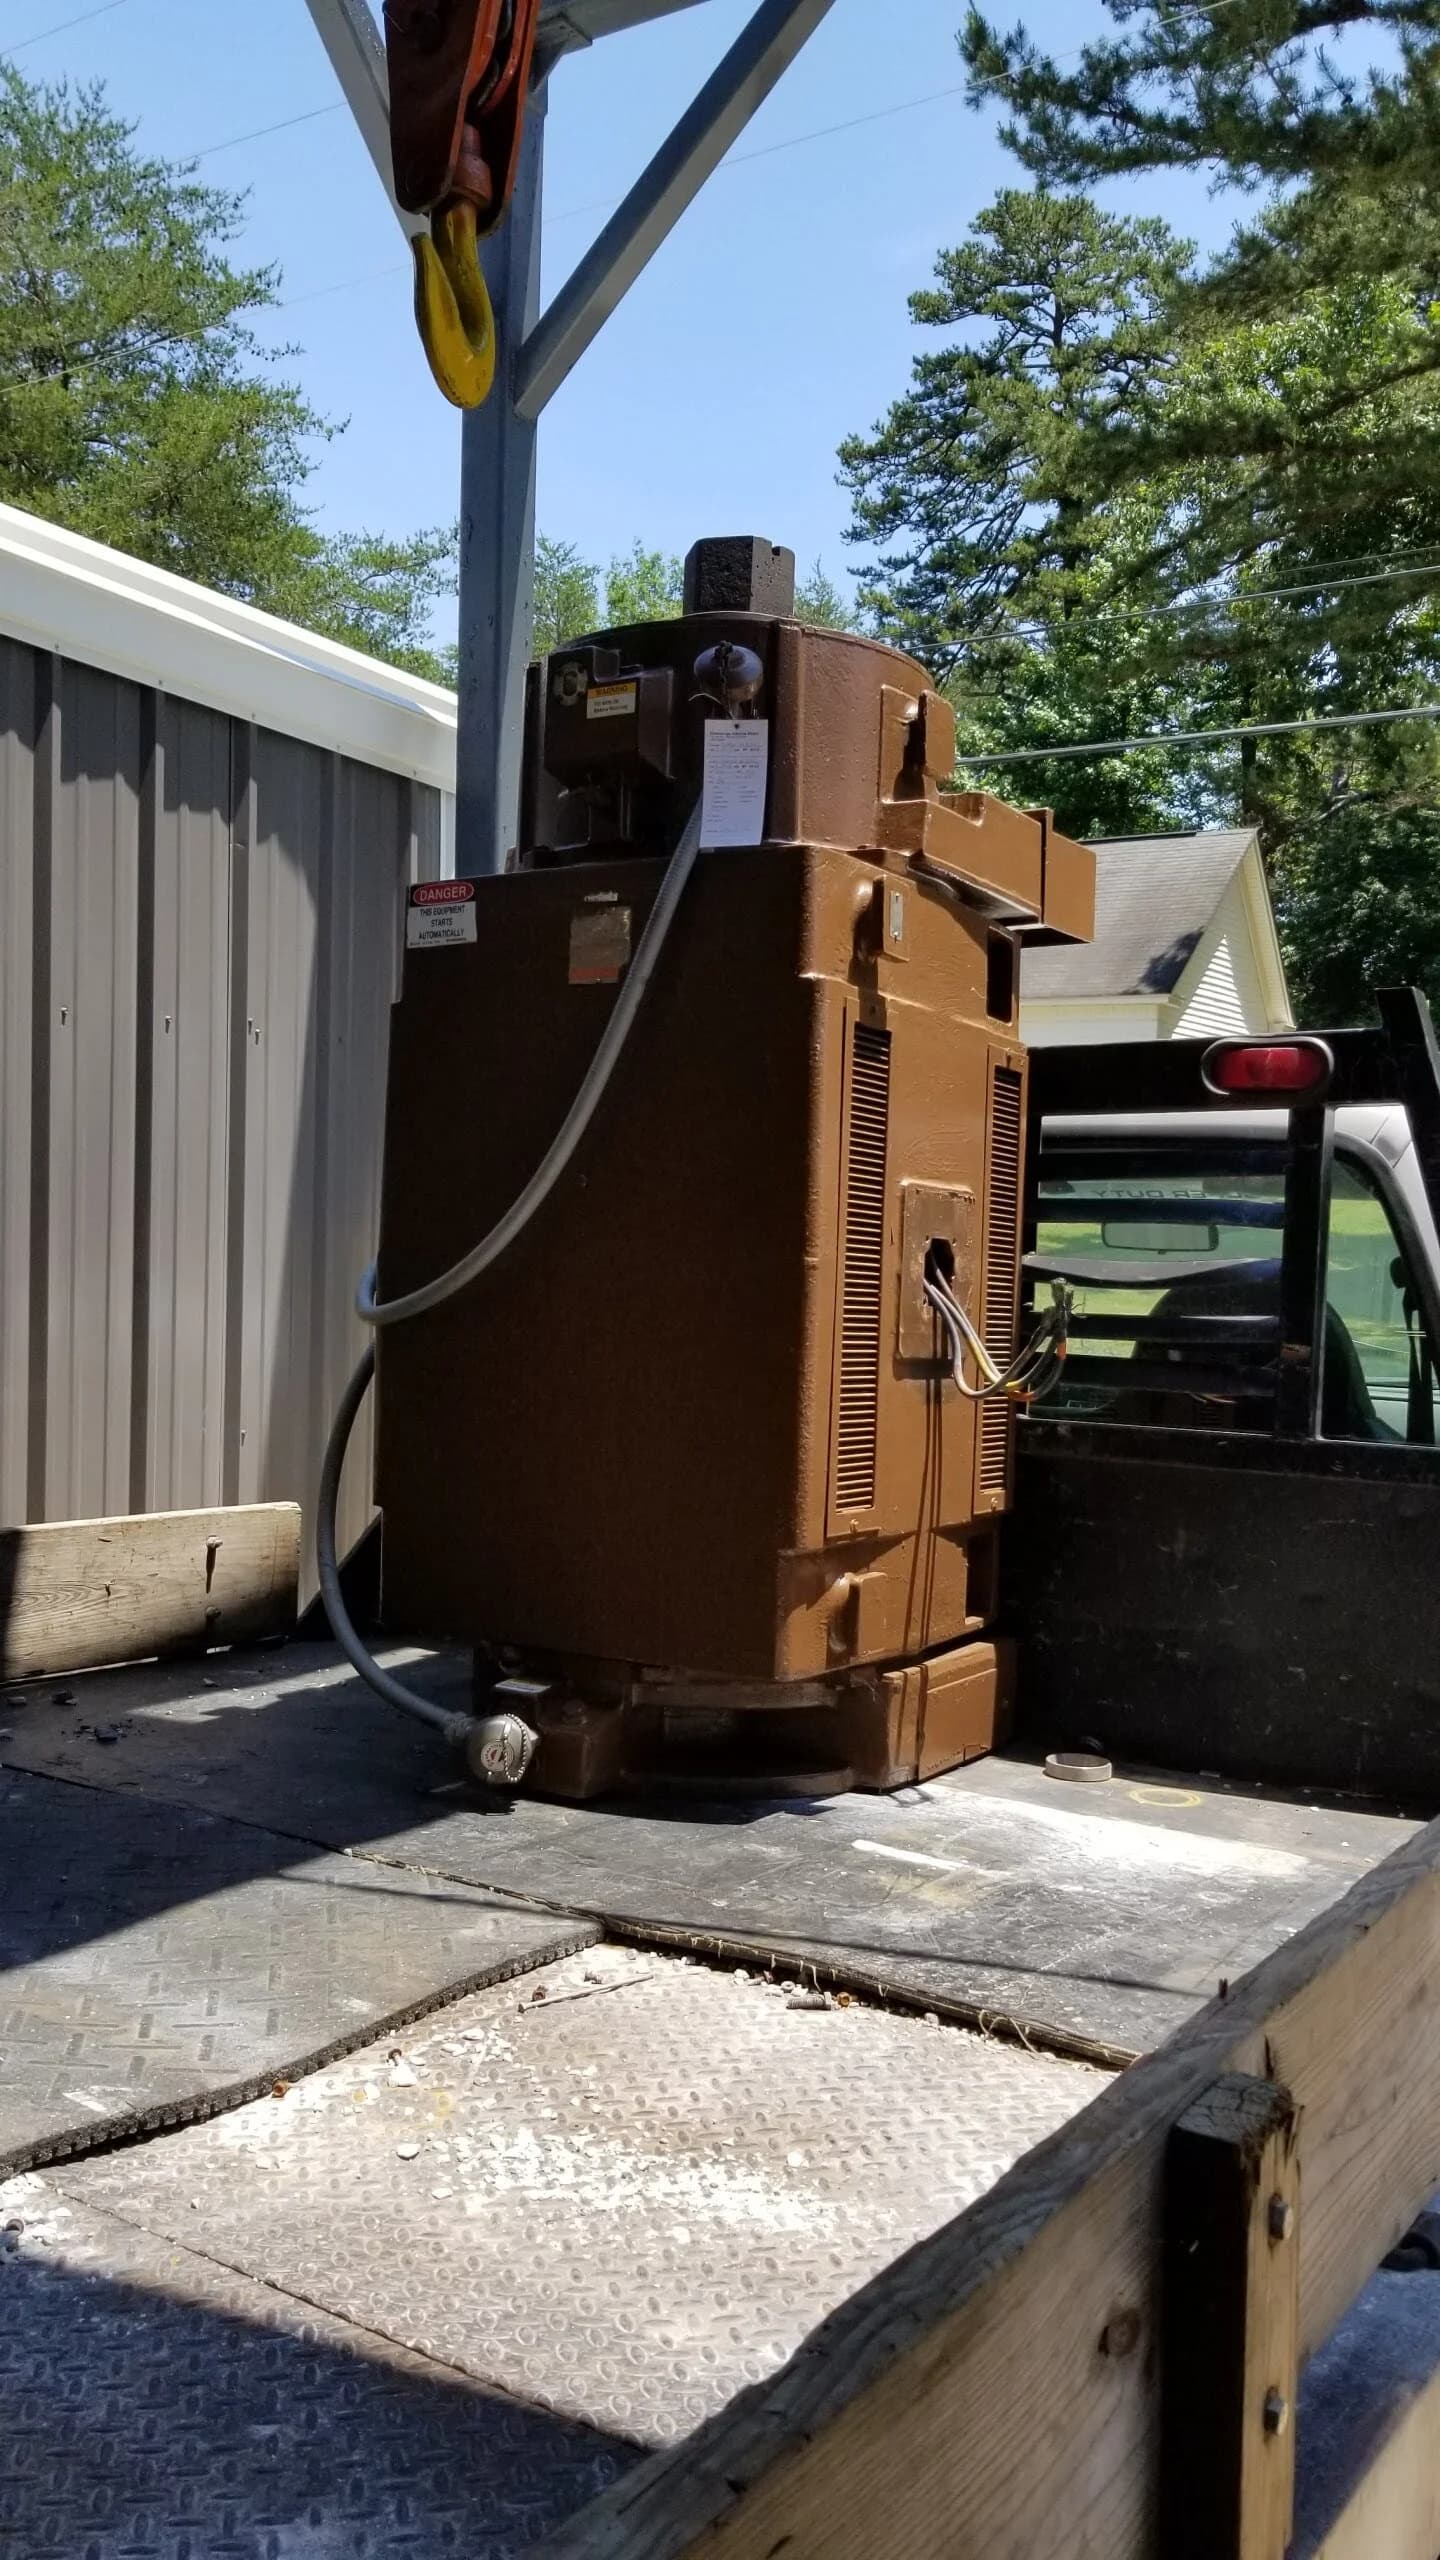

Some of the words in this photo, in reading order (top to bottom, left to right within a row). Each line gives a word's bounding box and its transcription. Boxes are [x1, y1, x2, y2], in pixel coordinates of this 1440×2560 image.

[419, 886, 467, 902] DANGER
[420, 908, 432, 916] THIS
[433, 905, 465, 915] EQUIPMENT
[431, 918, 453, 927] STARTS
[419, 928, 465, 940] AUTOMATICALLY
